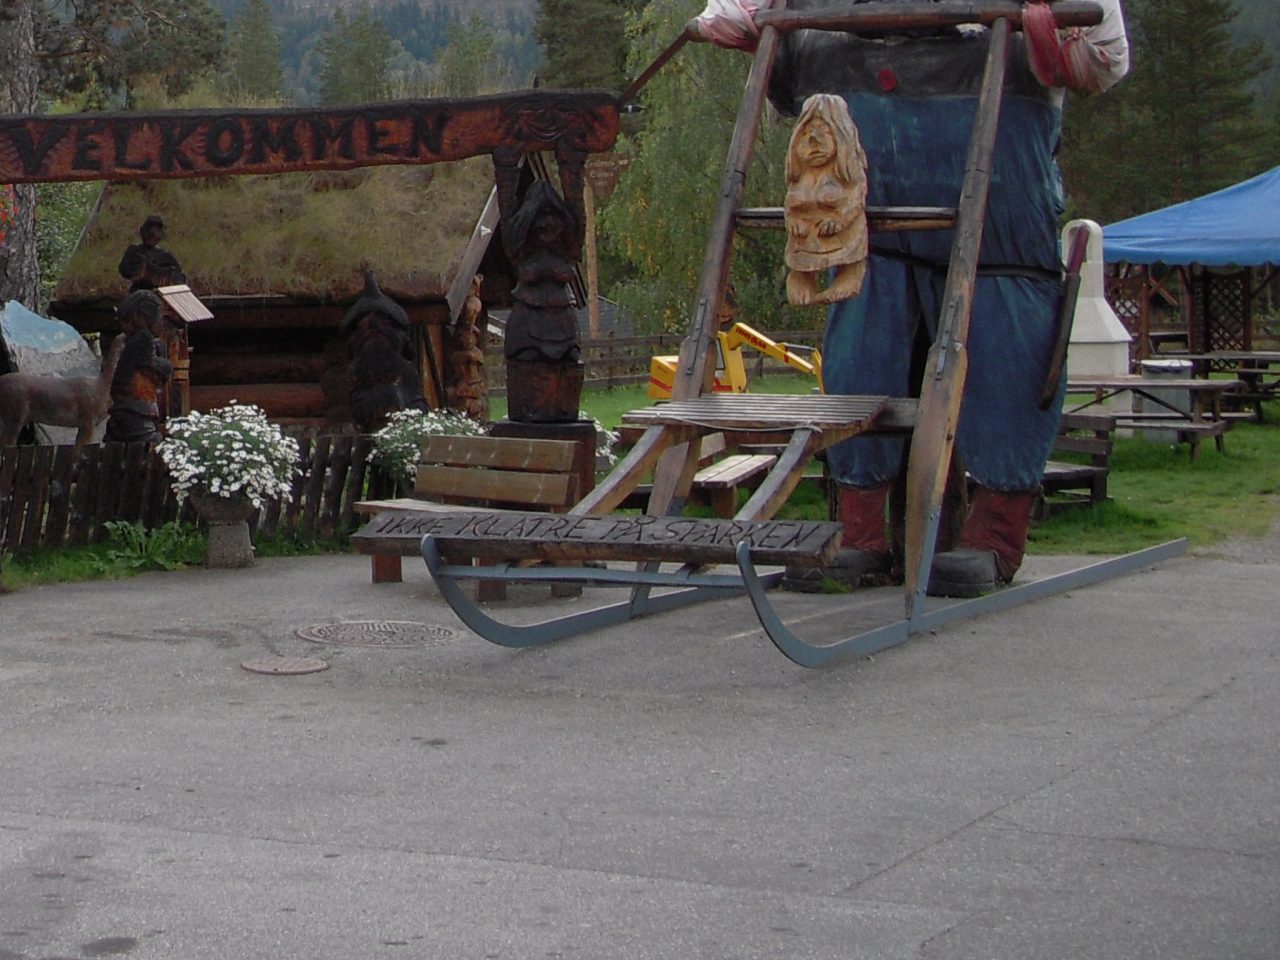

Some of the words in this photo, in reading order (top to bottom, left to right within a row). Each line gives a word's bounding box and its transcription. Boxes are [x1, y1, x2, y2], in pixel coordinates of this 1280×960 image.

[9, 109, 450, 174] VELKOMMEN
[375, 516, 452, 535] IKKE
[454, 515, 603, 539] KLATRE
[600, 515, 656, 542] PÅ
[651, 519, 821, 549] SPARKEN
